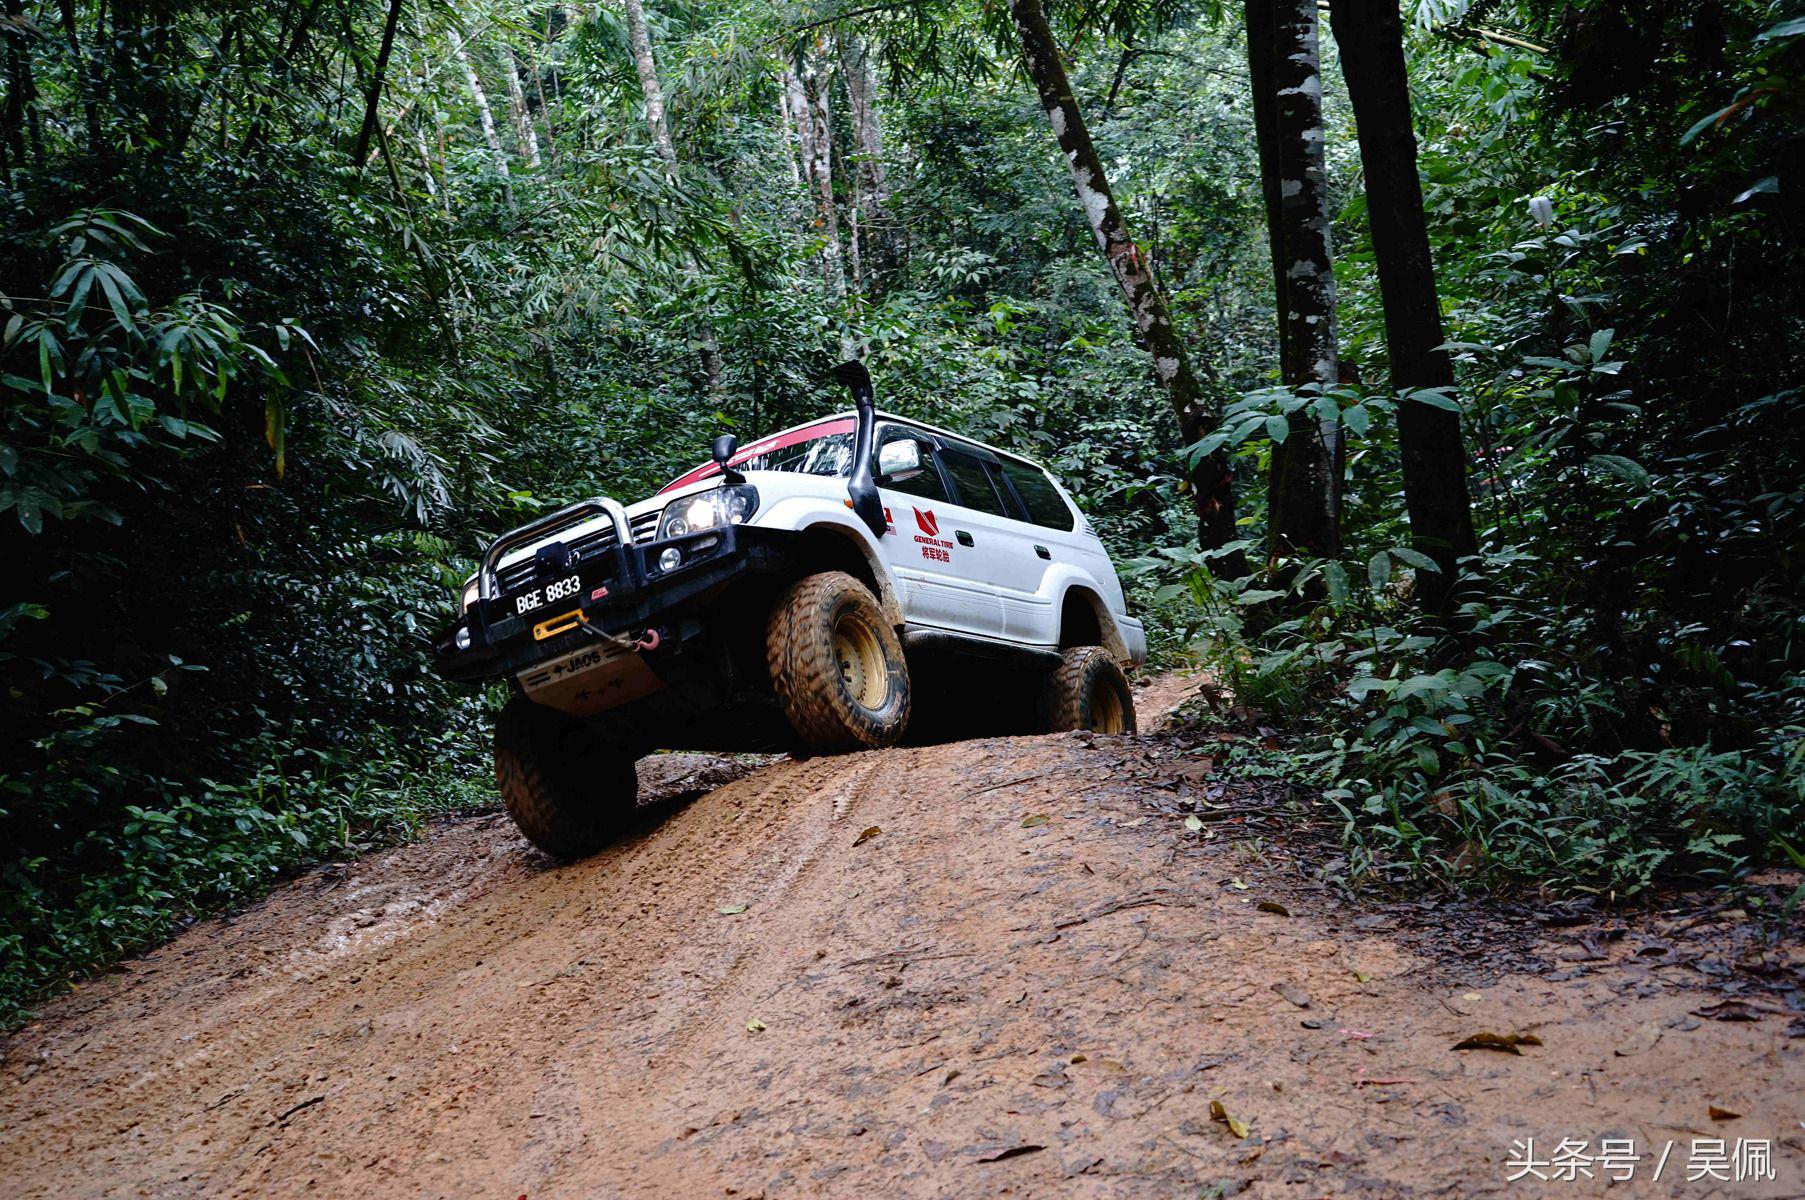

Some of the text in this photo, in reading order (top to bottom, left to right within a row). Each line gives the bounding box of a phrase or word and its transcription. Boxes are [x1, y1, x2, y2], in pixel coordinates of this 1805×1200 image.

[914, 535, 954, 550] GENERAL TIRE
[922, 546, 950, 563] 将军轮胎
[516, 589, 544, 614] BGE
[545, 575, 581, 602] 8833
